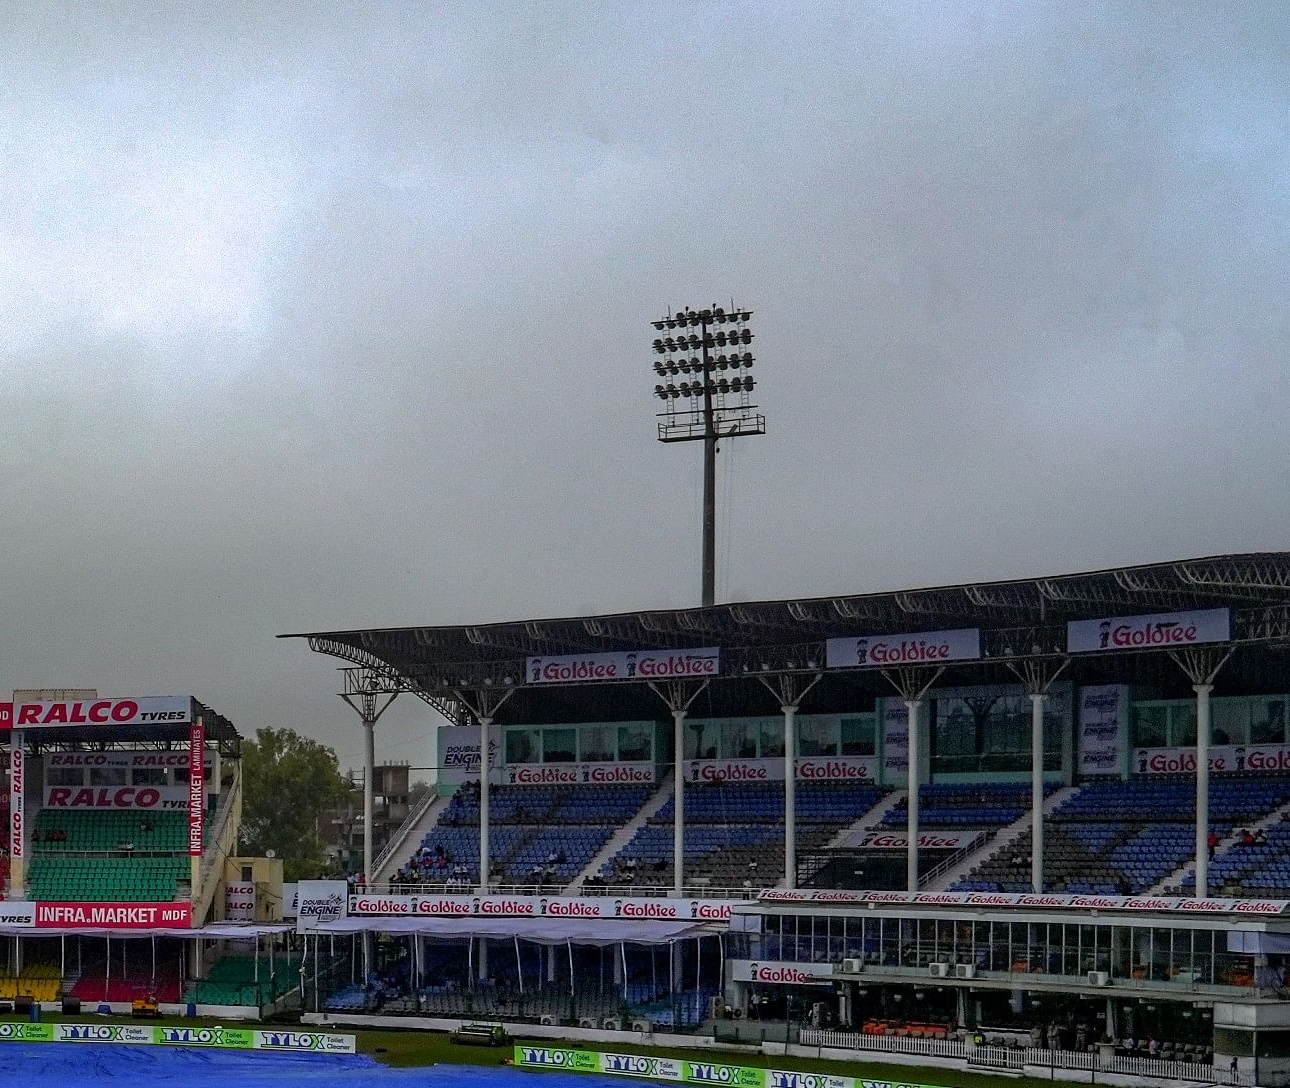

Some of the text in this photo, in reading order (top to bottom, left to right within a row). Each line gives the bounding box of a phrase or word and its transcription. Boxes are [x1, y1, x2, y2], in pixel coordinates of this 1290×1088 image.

[870, 641, 950, 663] Goldiee
[543, 655, 714, 680] Goldiee Goldiee
[17, 701, 139, 724] RALCO
[140, 710, 187, 721] TYRES
[14, 751, 23, 794] RALCO
[518, 766, 652, 783] Goldiee Goldiee
[701, 762, 868, 782] Goldiee Goldiee
[47, 787, 160, 808] RALCO
[192, 729, 202, 852] INFRA.MARKET LAMINATES
[14, 812, 23, 856] RALCO
[39, 907, 157, 924] INFRA.MARKET
[162, 909, 188, 921] MDF
[300, 906, 341, 915] ENGINE
[358, 900, 676, 917] Goldiee Goldiee Goldiee Goldiee Goldiee
[61, 1025, 124, 1041] TYLOX
[261, 1031, 325, 1050] TYLOX
[521, 1047, 574, 1067] TYLOX
[689, 1063, 739, 1085] TYLOX
